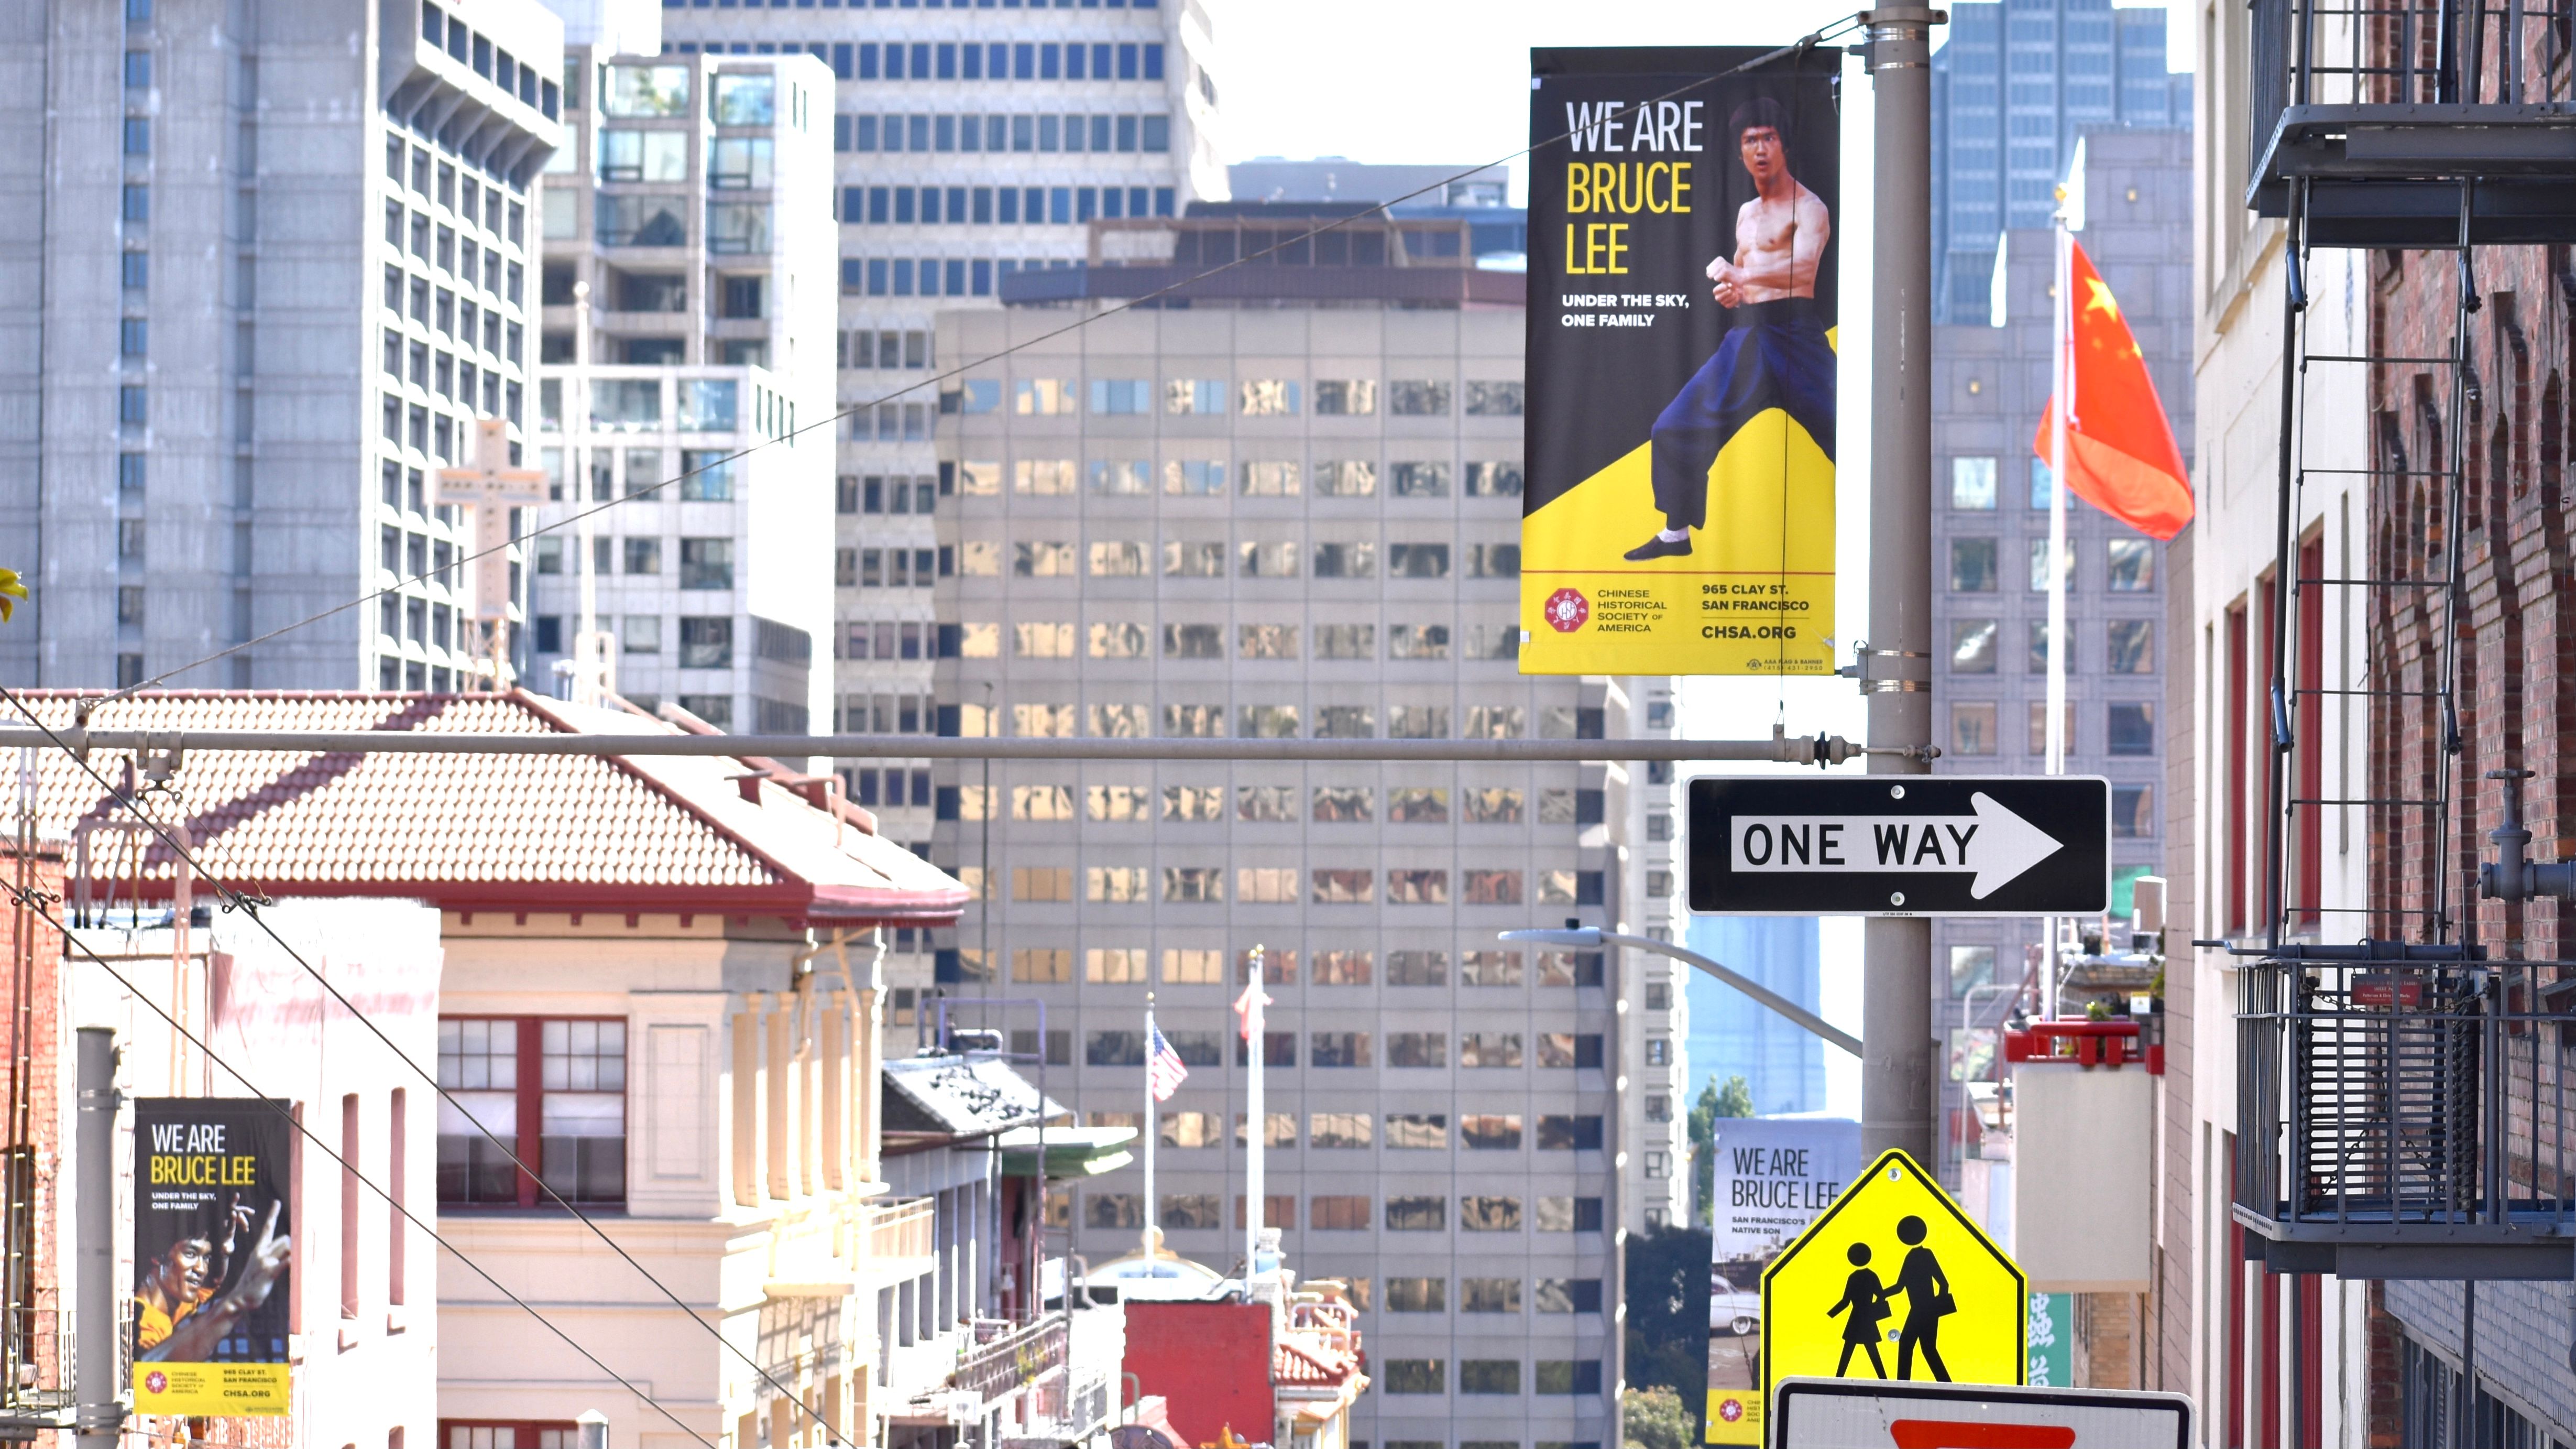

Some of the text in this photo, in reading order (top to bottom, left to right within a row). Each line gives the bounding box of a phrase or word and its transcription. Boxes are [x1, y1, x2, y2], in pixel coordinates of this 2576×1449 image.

[1566, 101, 1703, 152] WE ARE
[1567, 161, 1692, 213] BRUCE
[1566, 223, 1629, 274] LEE
[1562, 295, 1690, 309] UNDER THE SKY,
[1562, 314, 1654, 327] ONE FAMILY
[1702, 585, 1789, 595] 965 CLAY ST.
[1702, 601, 1810, 611] SAN FRANCISCO
[1598, 613, 1648, 621] SOCIETY
[1702, 626, 1796, 639] CHSA.ORG
[1743, 823, 1979, 866] ONE WAY
[152, 1124, 225, 1153] WE ARE
[151, 1156, 256, 1185] BRUCE LEE
[1733, 1148, 1808, 1176] WE ARE
[199, 1192, 216, 1201] SKY,
[1732, 1180, 1839, 1210] BRUCE LEE
[1751, 1217, 1805, 1225] FRANCISCO'S
